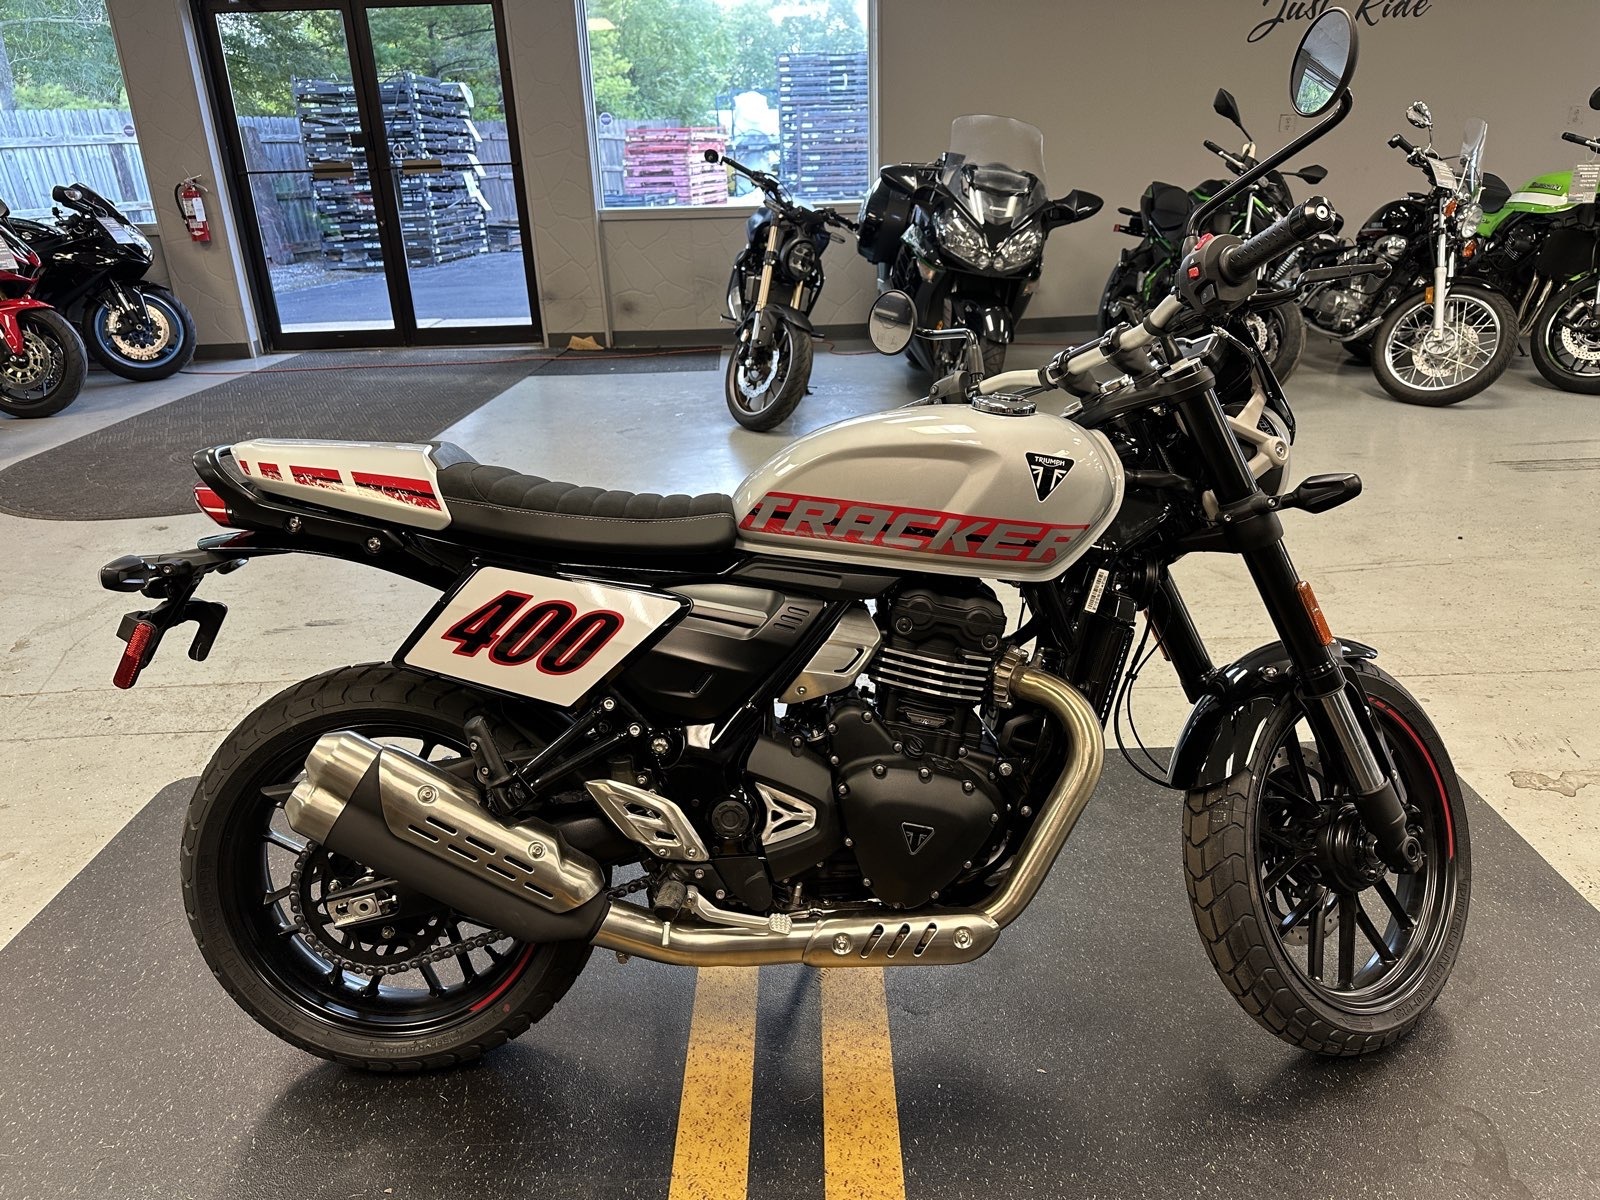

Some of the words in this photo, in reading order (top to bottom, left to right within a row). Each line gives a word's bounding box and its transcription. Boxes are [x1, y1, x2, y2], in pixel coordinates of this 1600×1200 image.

[1247, 0, 1330, 42] Jus
[1355, 0, 1432, 26] Ride
[1034, 456, 1065, 467] TRIUMPH
[752, 495, 1085, 561] TRACKER
[441, 590, 625, 675] 400
